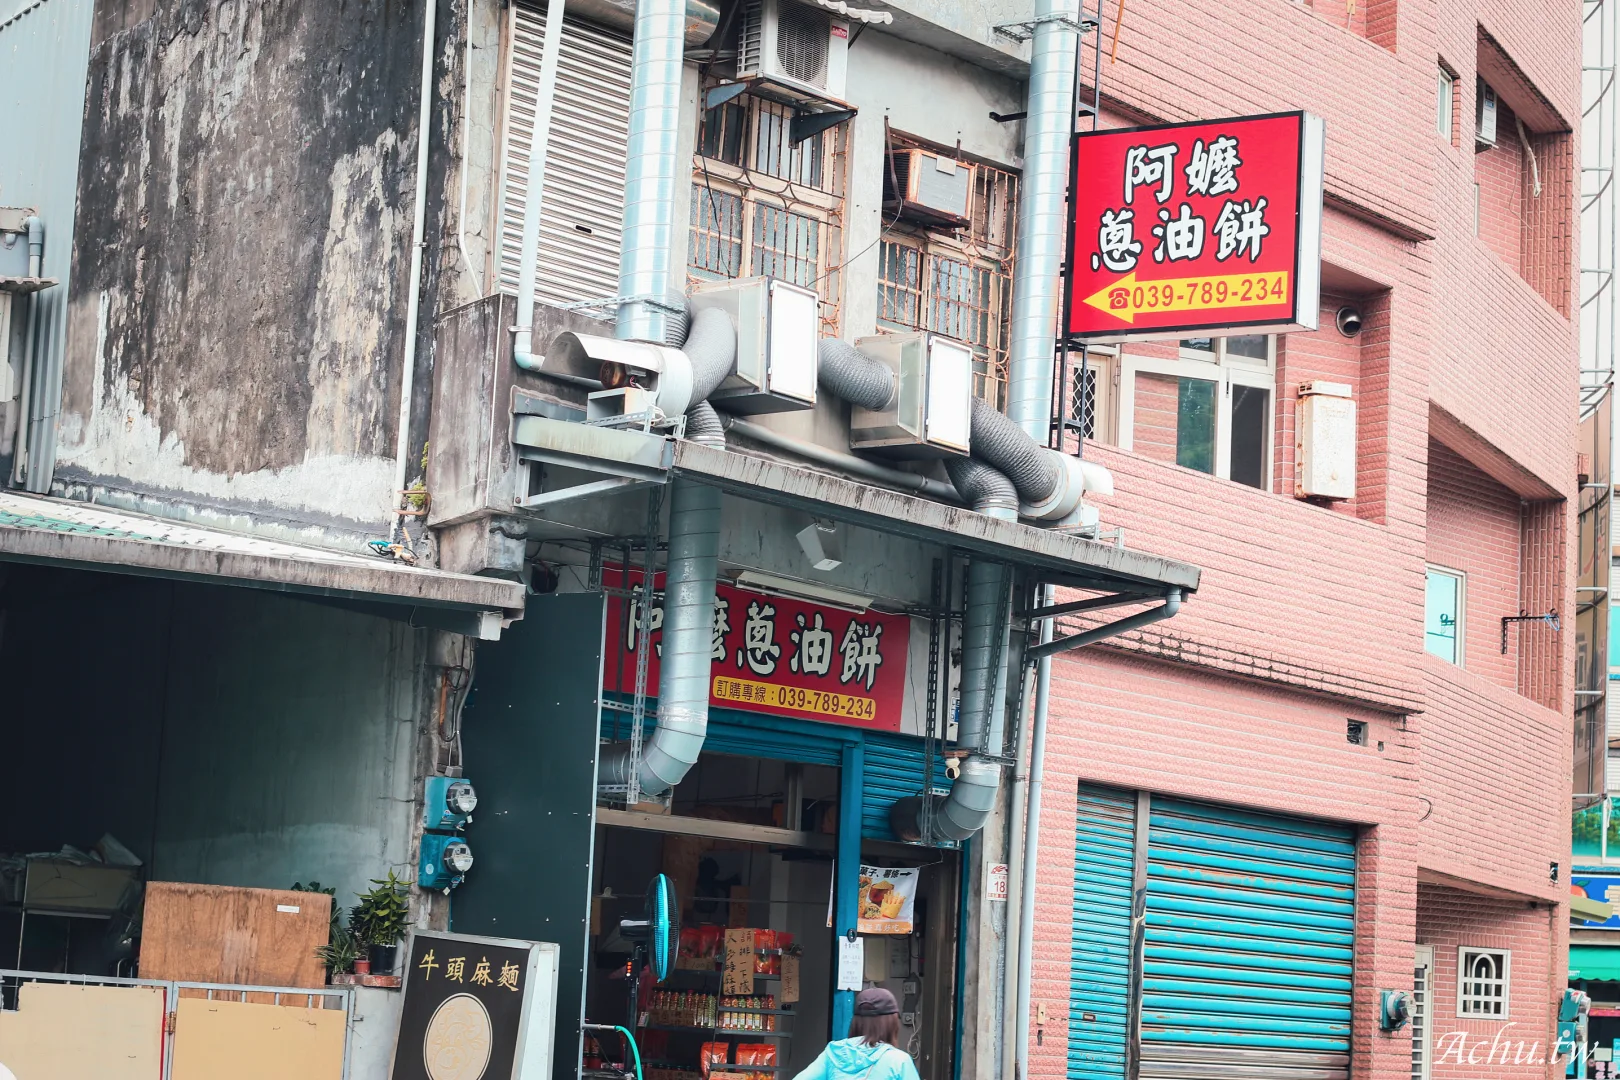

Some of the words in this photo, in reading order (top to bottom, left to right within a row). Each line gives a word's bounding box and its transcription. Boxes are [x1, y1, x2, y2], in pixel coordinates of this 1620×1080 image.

[1125, 136, 1242, 204] 阿嬤
[1092, 198, 1270, 271] 蔥油餅
[1132, 276, 1284, 309] 039-789-234
[994, 880, 1006, 893] 18
[418, 949, 520, 992] 牛頭麻麵
